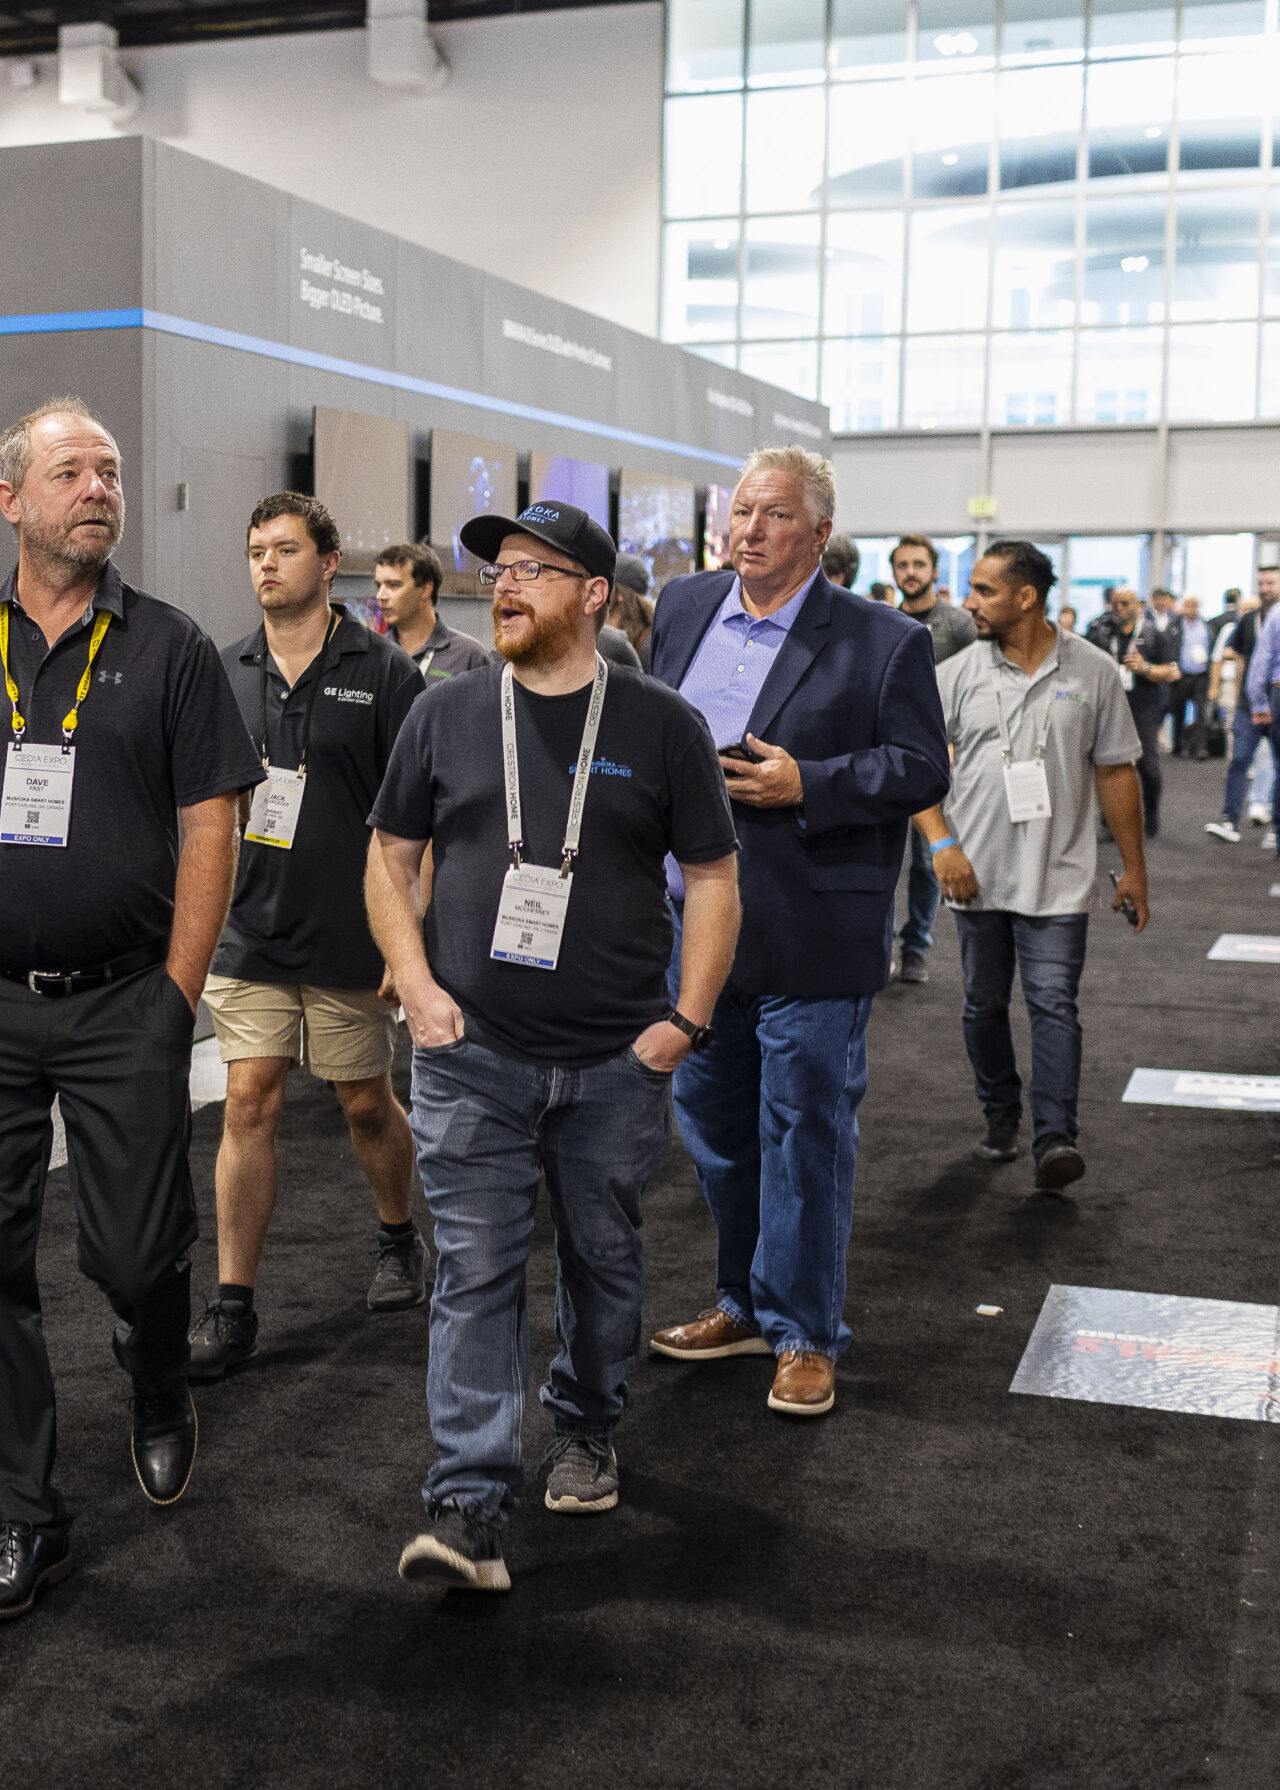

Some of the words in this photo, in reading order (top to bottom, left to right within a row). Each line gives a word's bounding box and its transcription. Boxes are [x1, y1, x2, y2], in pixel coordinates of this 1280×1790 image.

[324, 687, 337, 696] GE
[338, 688, 374, 702] Lighting
[588, 681, 605, 727] CRESTRON
[504, 698, 513, 722] HOME
[15, 754, 42, 763] CEDIA
[44, 756, 67, 765] EXPO
[506, 743, 516, 792] CRESTRON
[601, 767, 633, 778] HOMES
[26, 778, 49, 787] DAVE
[570, 776, 585, 826] CRESTRON
[580, 748, 591, 776] HOME
[509, 791, 519, 820] HOME
[524, 898, 542, 909] NEIL
